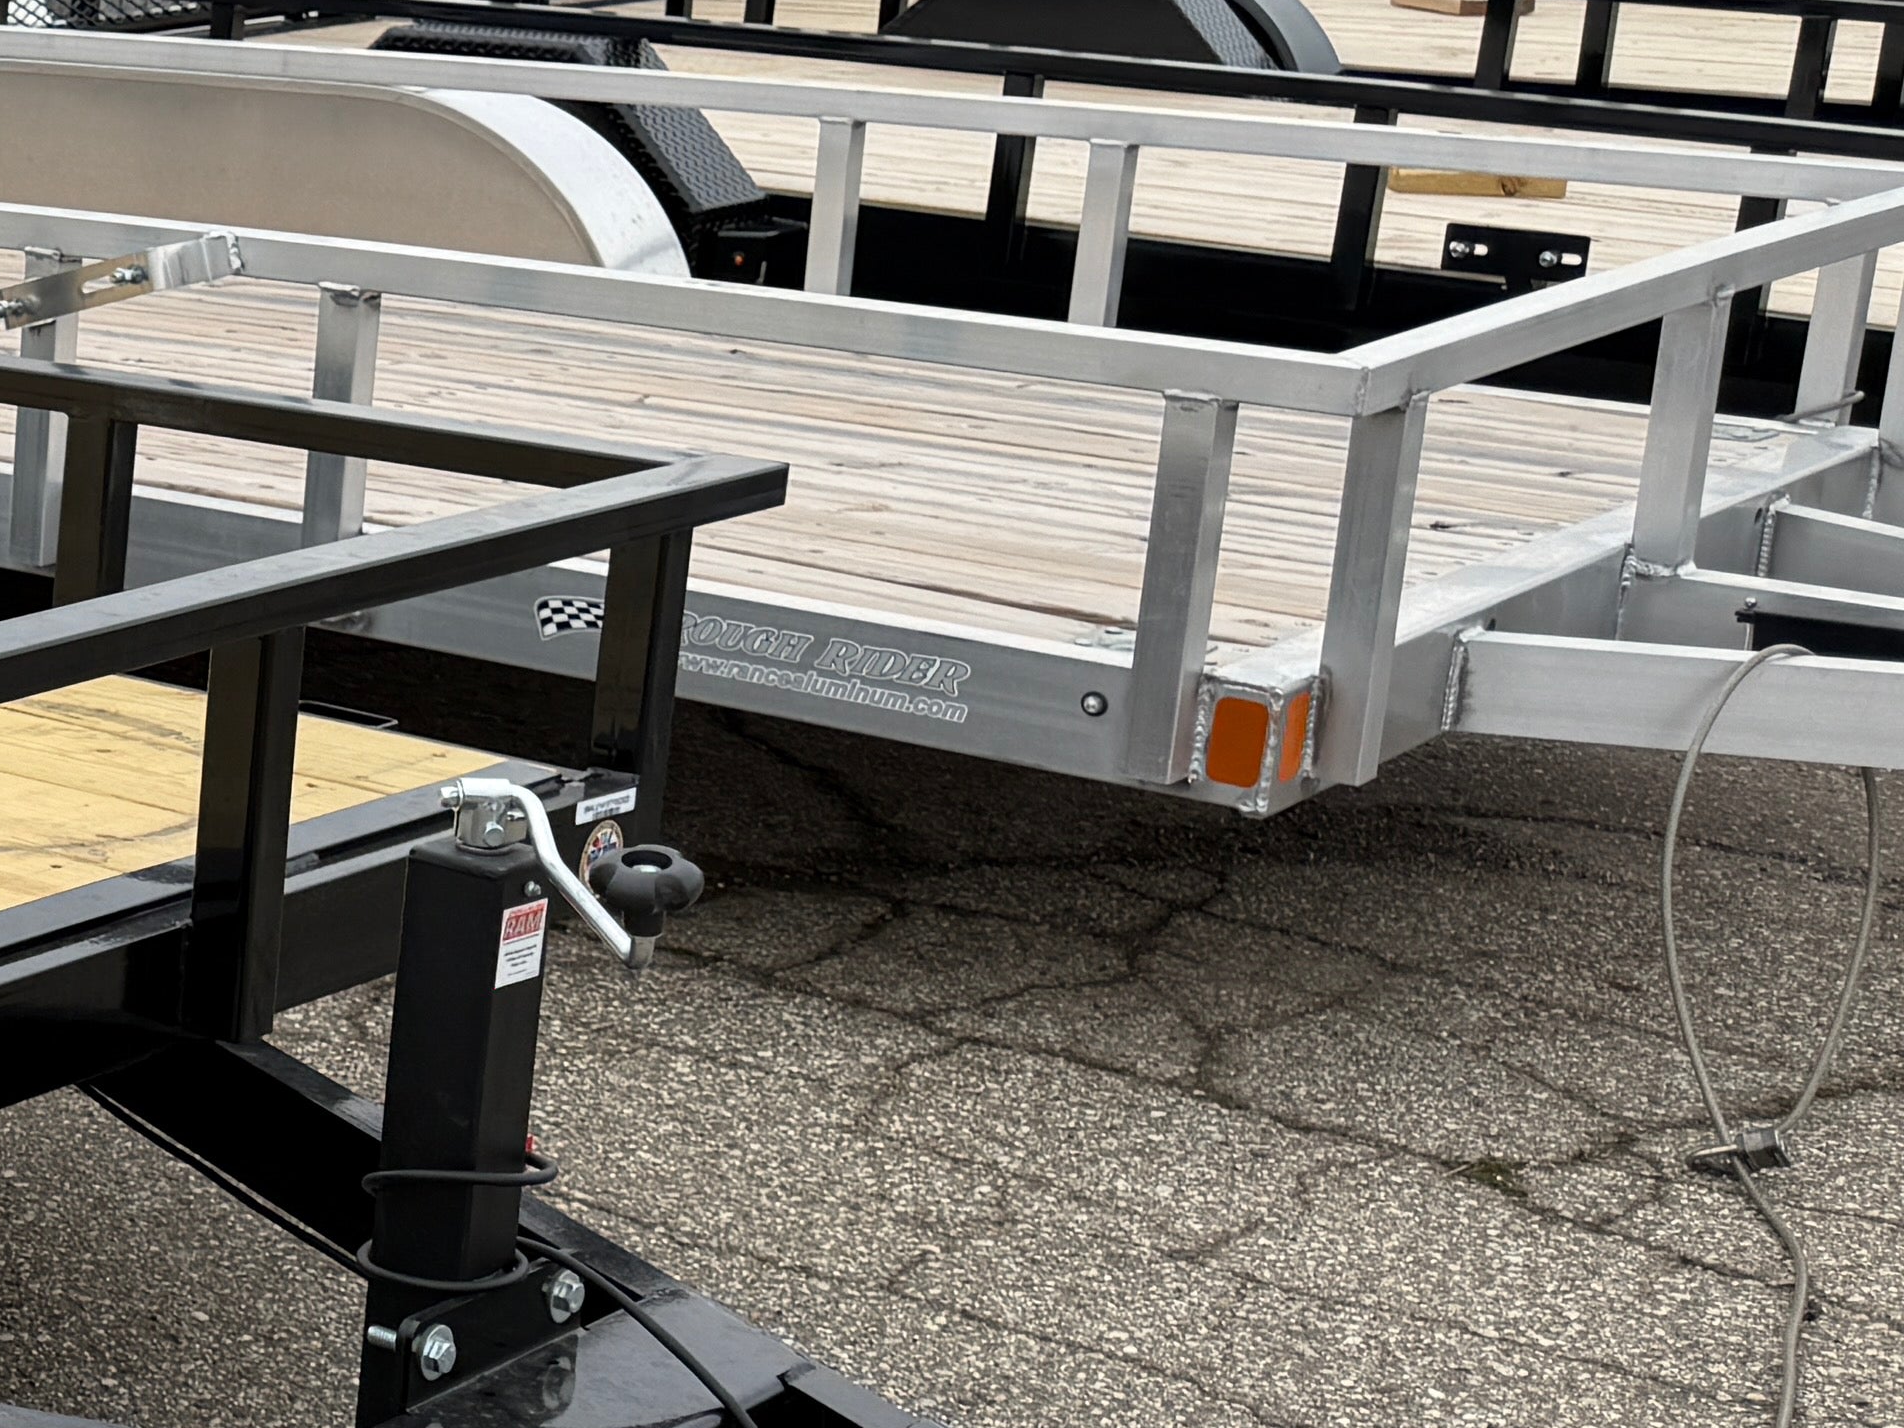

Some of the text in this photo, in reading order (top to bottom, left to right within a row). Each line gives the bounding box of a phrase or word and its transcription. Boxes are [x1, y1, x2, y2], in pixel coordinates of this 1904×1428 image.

[678, 652, 968, 723] ww.rancealuminum.com
[814, 638, 971, 697] RIDER
[504, 910, 543, 940] RAM
